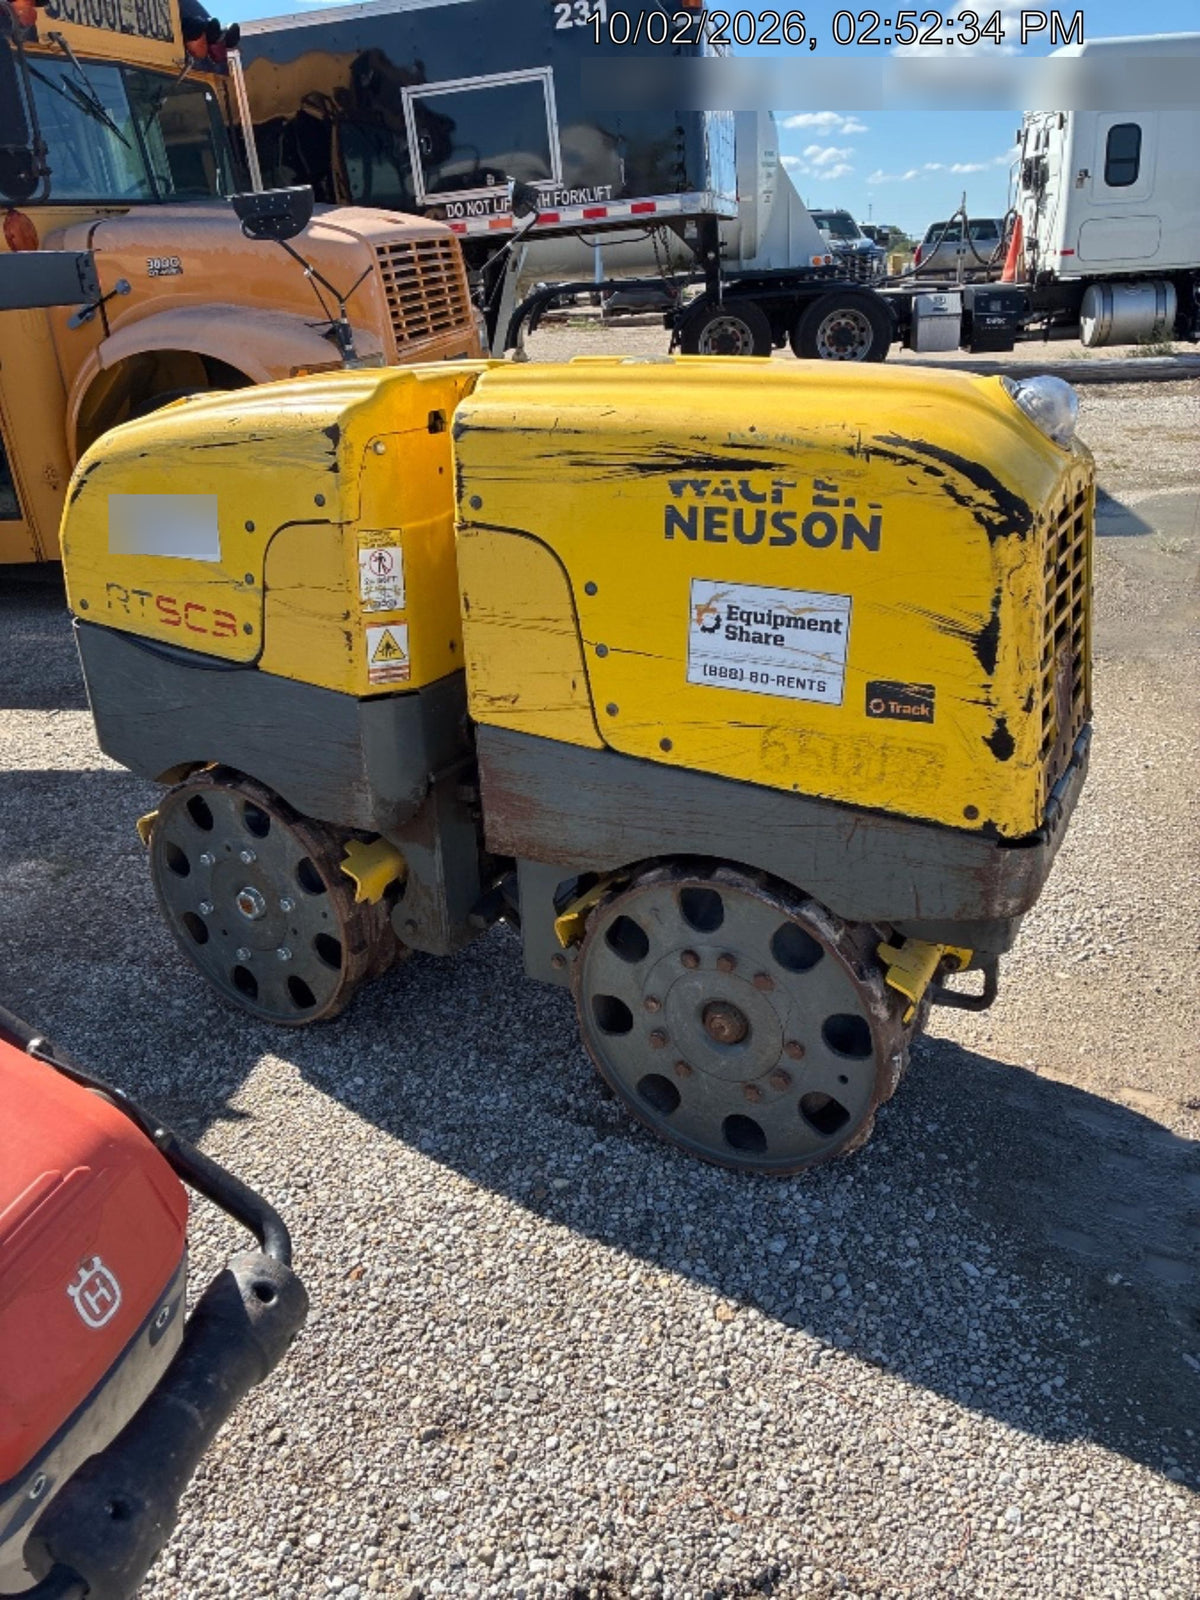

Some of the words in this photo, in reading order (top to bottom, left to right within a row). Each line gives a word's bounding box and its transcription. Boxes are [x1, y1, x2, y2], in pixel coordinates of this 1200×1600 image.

[554, 0, 607, 29] 231
[446, 203, 464, 218] DO
[467, 200, 491, 215] NOT
[494, 197, 512, 213] LIF
[554, 185, 612, 206] FORKLIFT
[665, 504, 883, 552] NEUSON
[726, 604, 843, 634] Equipment
[725, 624, 786, 647] Share
[703, 663, 745, 682] (888)
[750, 671, 828, 693] 80-RENTS
[888, 700, 931, 717] Track
